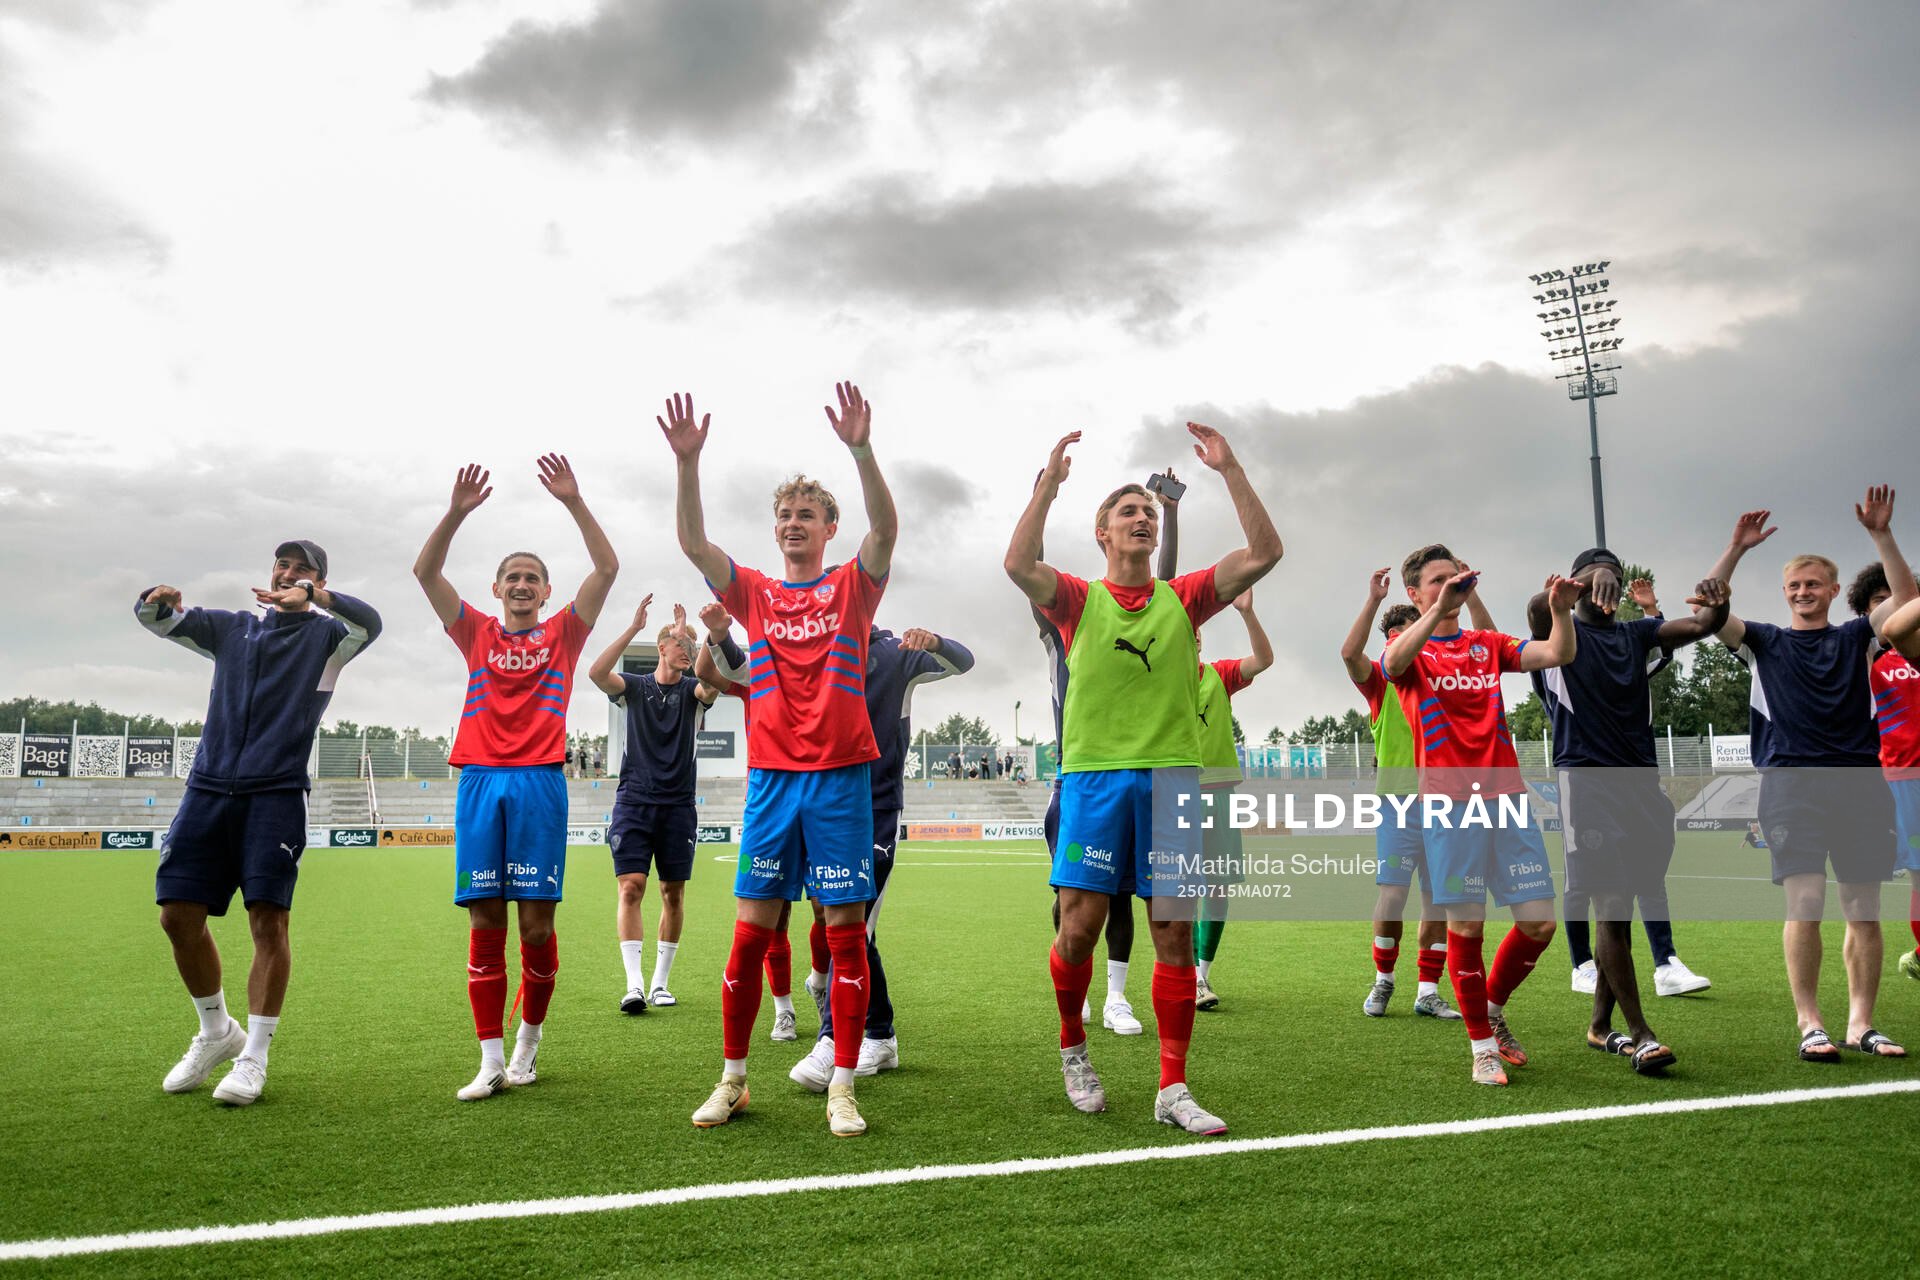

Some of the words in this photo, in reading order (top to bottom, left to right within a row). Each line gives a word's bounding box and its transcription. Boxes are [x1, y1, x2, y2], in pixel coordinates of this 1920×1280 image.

[763, 611, 840, 641] vobbiz
[487, 647, 550, 671] vobbiz
[1426, 668, 1500, 692] vobbiz
[23, 745, 69, 769] Bagt
[128, 747, 171, 769] Bagt
[1687, 821, 1714, 830] CRAFT
[19, 834, 46, 846] Café
[49, 834, 97, 848] Chaplin
[107, 832, 148, 847] Carlsberg
[335, 830, 371, 846] Carlsberg
[399, 832, 423, 843] Café
[1084, 845, 1112, 862] Solid
[507, 862, 538, 875] Fibio
[752, 856, 781, 870] Solid
[860, 858, 870, 871] 16
[1082, 857, 1116, 875] Försäkring
[1509, 861, 1543, 877] Fibio
[471, 869, 496, 881] Solid
[751, 868, 785, 880] Försäkring
[815, 865, 851, 879] Fibio
[512, 879, 539, 888] Resurs
[822, 880, 854, 890] Resurs
[1518, 879, 1547, 890] Resurs
